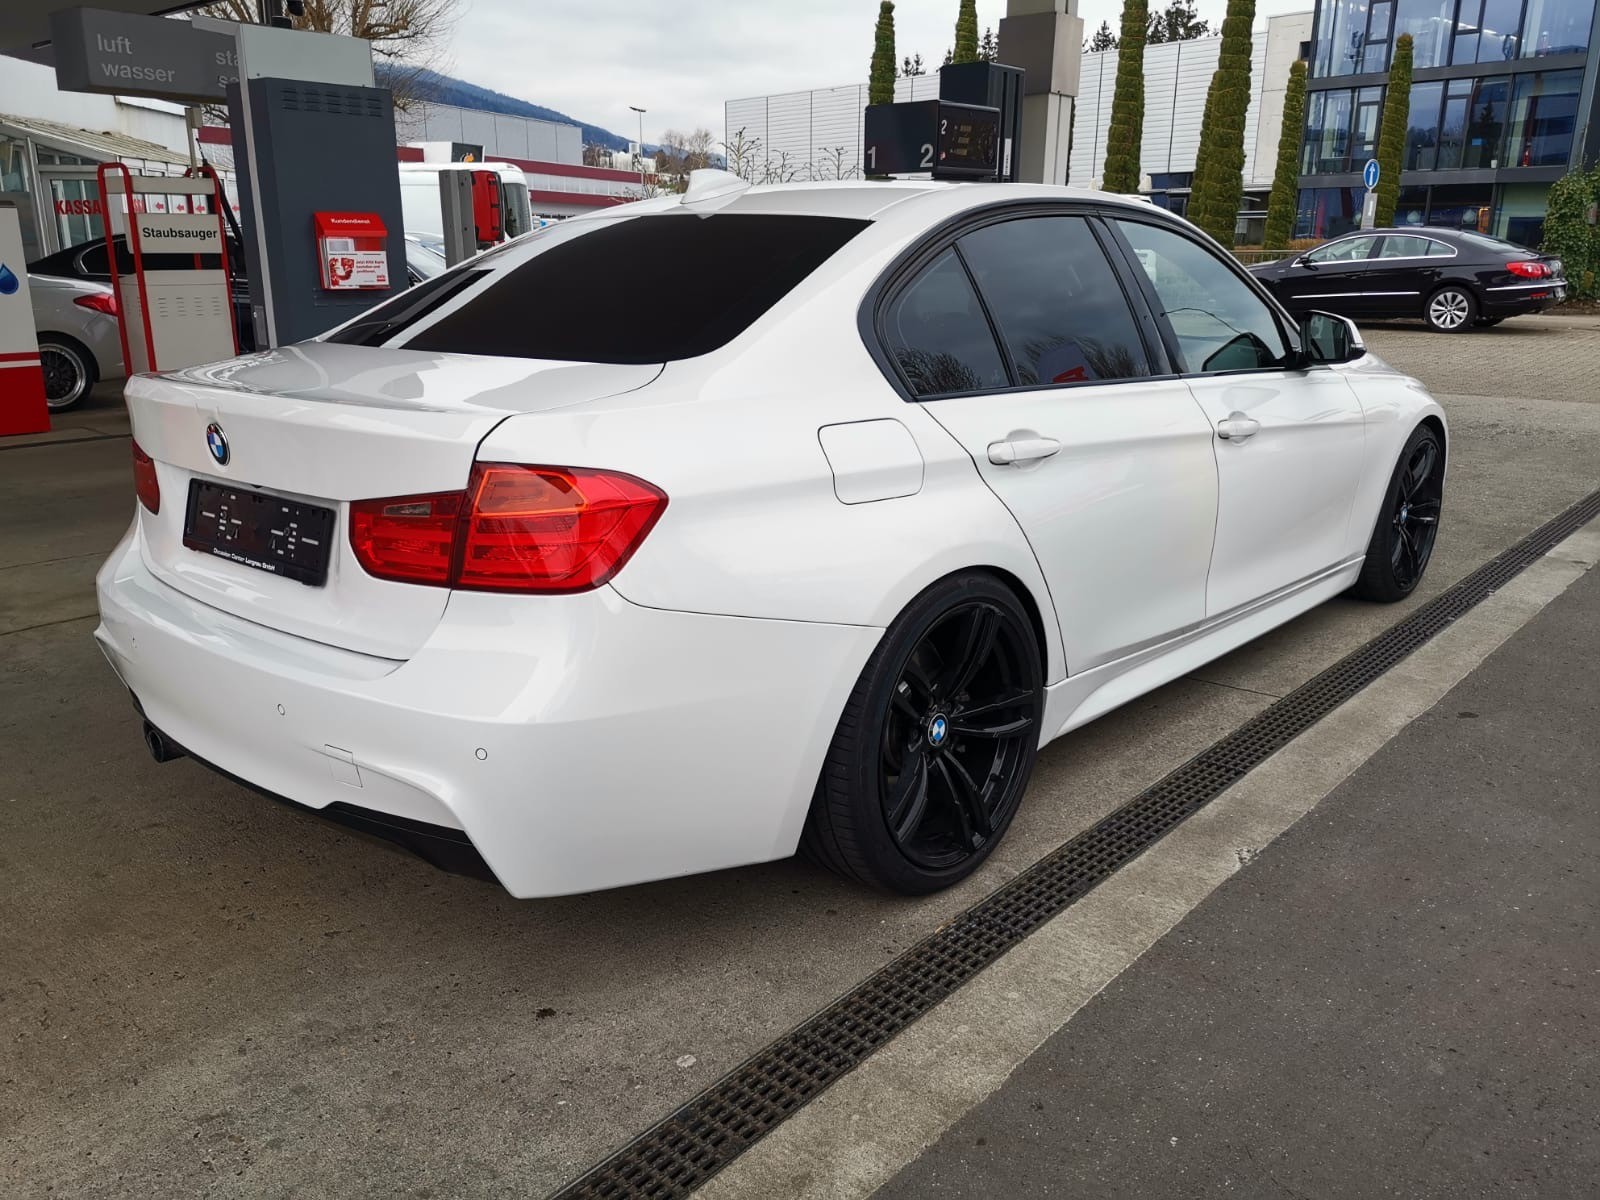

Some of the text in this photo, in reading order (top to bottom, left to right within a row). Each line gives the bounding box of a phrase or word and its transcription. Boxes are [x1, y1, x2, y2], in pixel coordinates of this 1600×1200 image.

[97, 34, 132, 55] luft
[102, 63, 175, 82] wasser
[941, 119, 948, 135] 2
[867, 146, 877, 169] 1
[919, 143, 934, 168] 2
[55, 199, 101, 215] KASSA
[142, 227, 218, 240] Staubsauger
